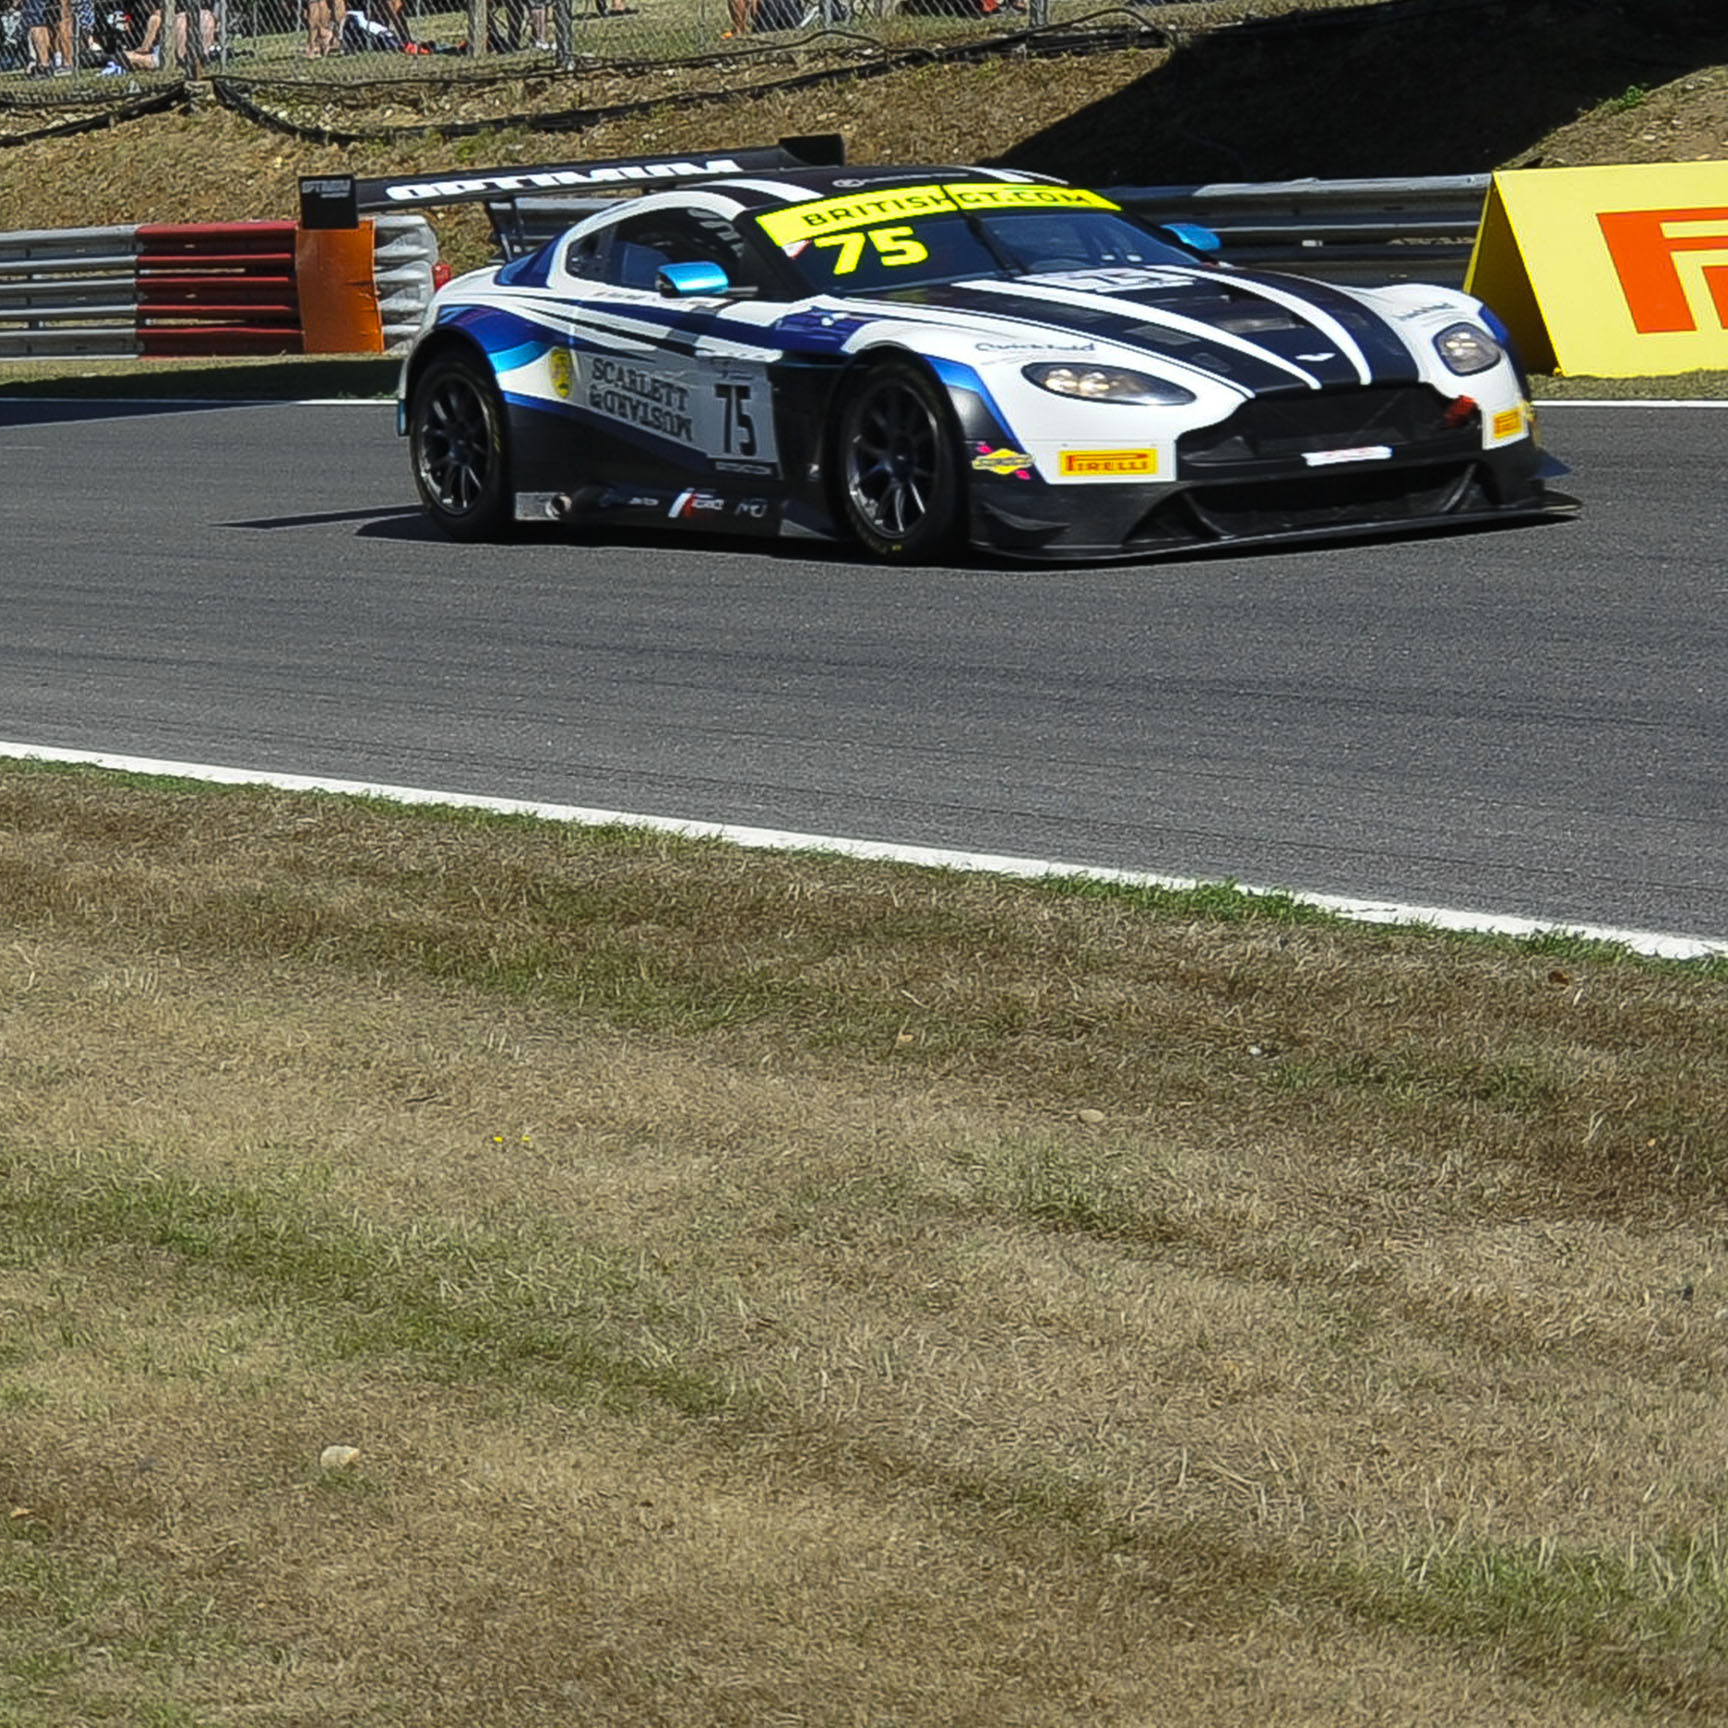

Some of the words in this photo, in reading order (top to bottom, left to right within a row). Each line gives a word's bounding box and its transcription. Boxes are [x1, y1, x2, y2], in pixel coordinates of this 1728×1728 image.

[386, 159, 743, 201] OPTIMUM
[814, 226, 929, 275] 75
[591, 357, 691, 412] SCARLETT
[714, 383, 758, 457] 75
[1065, 451, 1150, 472] PIRELLI
